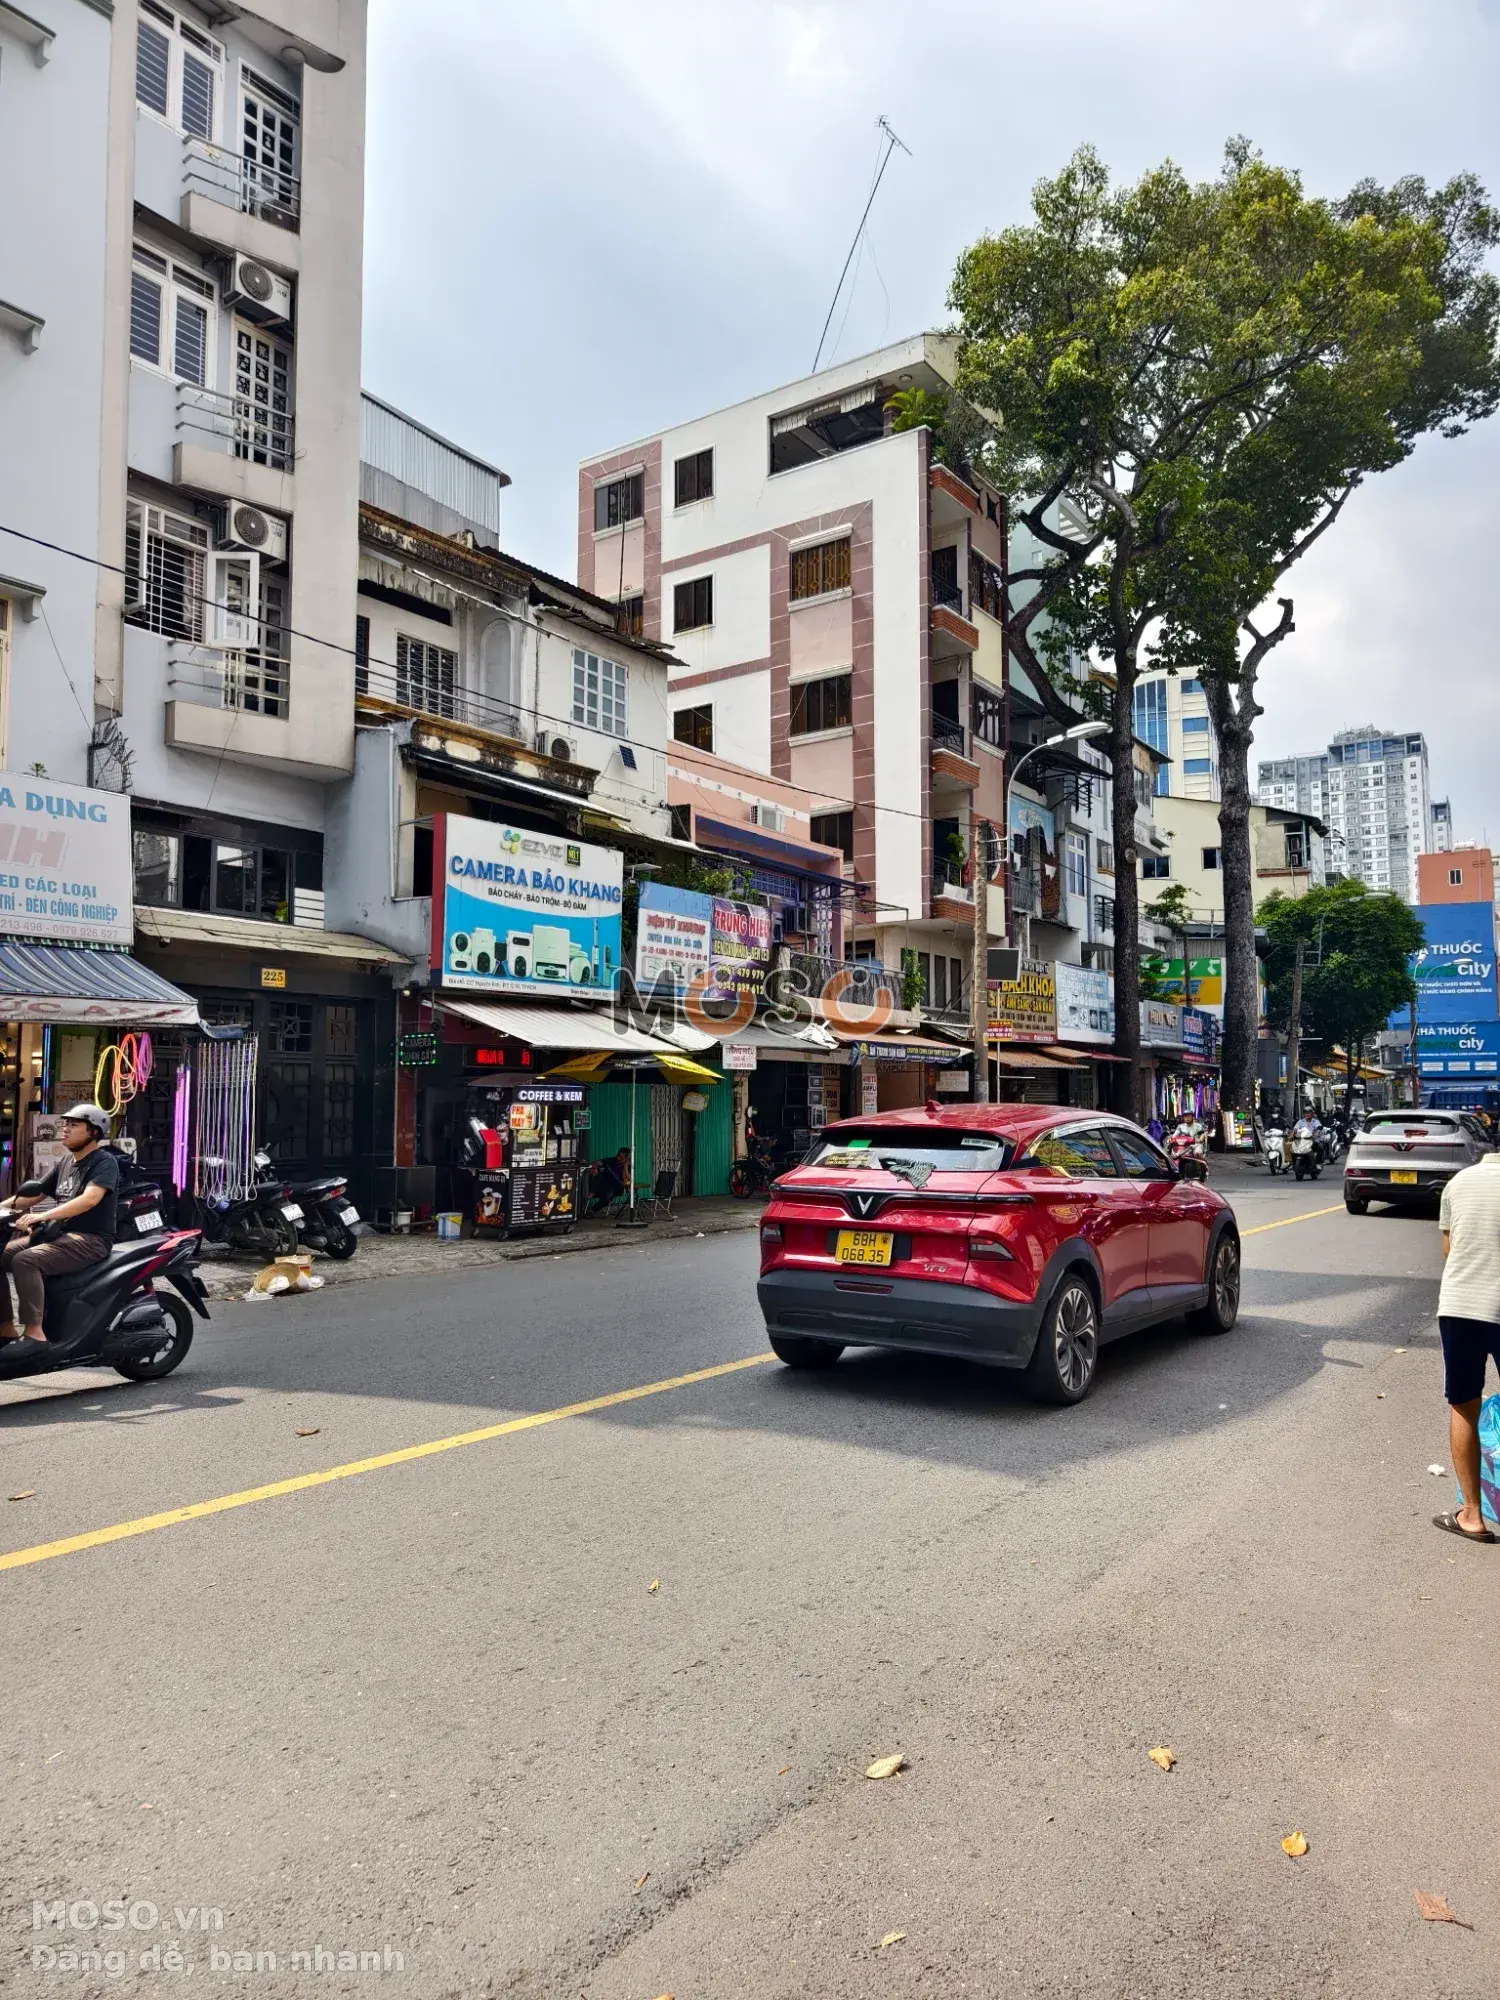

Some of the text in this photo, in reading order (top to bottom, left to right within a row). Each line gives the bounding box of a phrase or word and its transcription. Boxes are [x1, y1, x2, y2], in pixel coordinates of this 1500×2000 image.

[25, 791, 108, 822] DỤNG
[520, 838, 563, 858] EZVIZ
[25, 876, 57, 893] CÁC
[62, 882, 97, 900] LOẠI
[450, 855, 622, 904] CAMERA BẢO KHANG
[488, 887, 503, 898] BÁO
[504, 888, 523, 901] CHÁY
[541, 895, 561, 908] TRỘM
[563, 899, 572, 910] BỘ
[572, 900, 587, 911] ĐÀM
[26, 895, 47, 914] ĐÈN
[51, 898, 79, 918] CÔNG
[82, 903, 118, 925] NGHIỆP
[714, 909, 748, 936] TRUNG
[1430, 940, 1482, 955] THUỐC
[263, 970, 284, 982] 225
[1029, 975, 1055, 998] KHOA
[1437, 1024, 1477, 1036] THUỐC
[404, 1037, 432, 1048] CAMERA
[518, 1090, 553, 1101] COFFEE
[555, 1090, 563, 1101] &
[564, 1091, 583, 1101] KEM
[853, 1233, 877, 1247] 68H
[841, 1248, 884, 1263] 068.35
